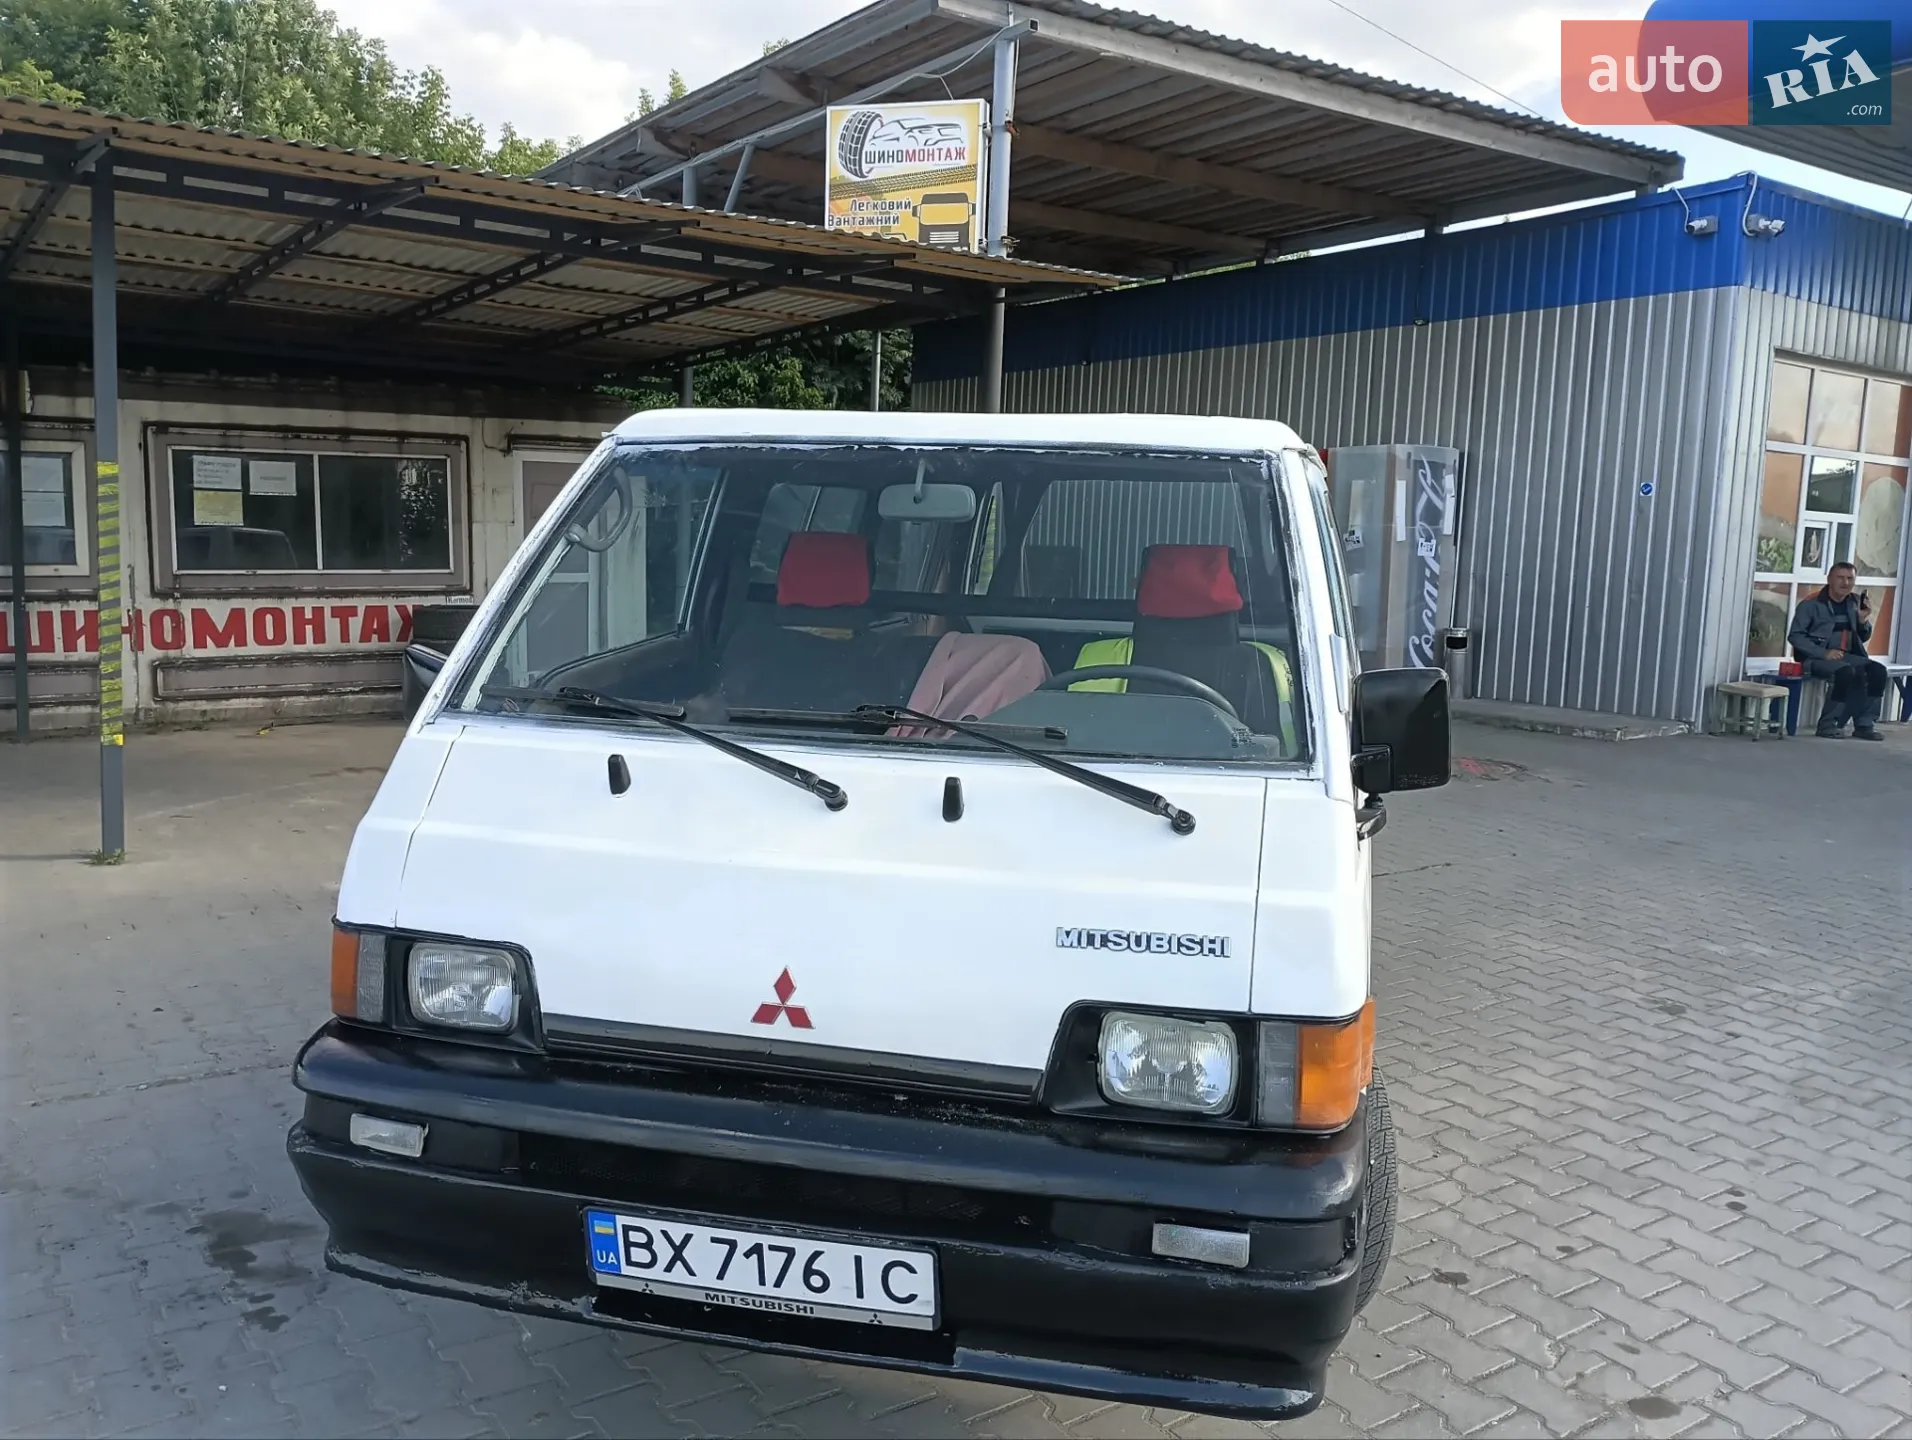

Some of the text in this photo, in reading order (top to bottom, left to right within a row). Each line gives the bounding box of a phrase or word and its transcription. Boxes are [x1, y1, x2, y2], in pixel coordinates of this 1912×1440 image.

[864, 146, 967, 165] ШИНОМОНТАЖ
[850, 198, 912, 212] Легковий
[828, 213, 900, 227] Вантажний
[1056, 926, 1232, 958] MITSUBISHI
[596, 1249, 618, 1265] UA
[622, 1224, 919, 1305] BX 7176 IC
[704, 1292, 815, 1315] MITSUBISHI
